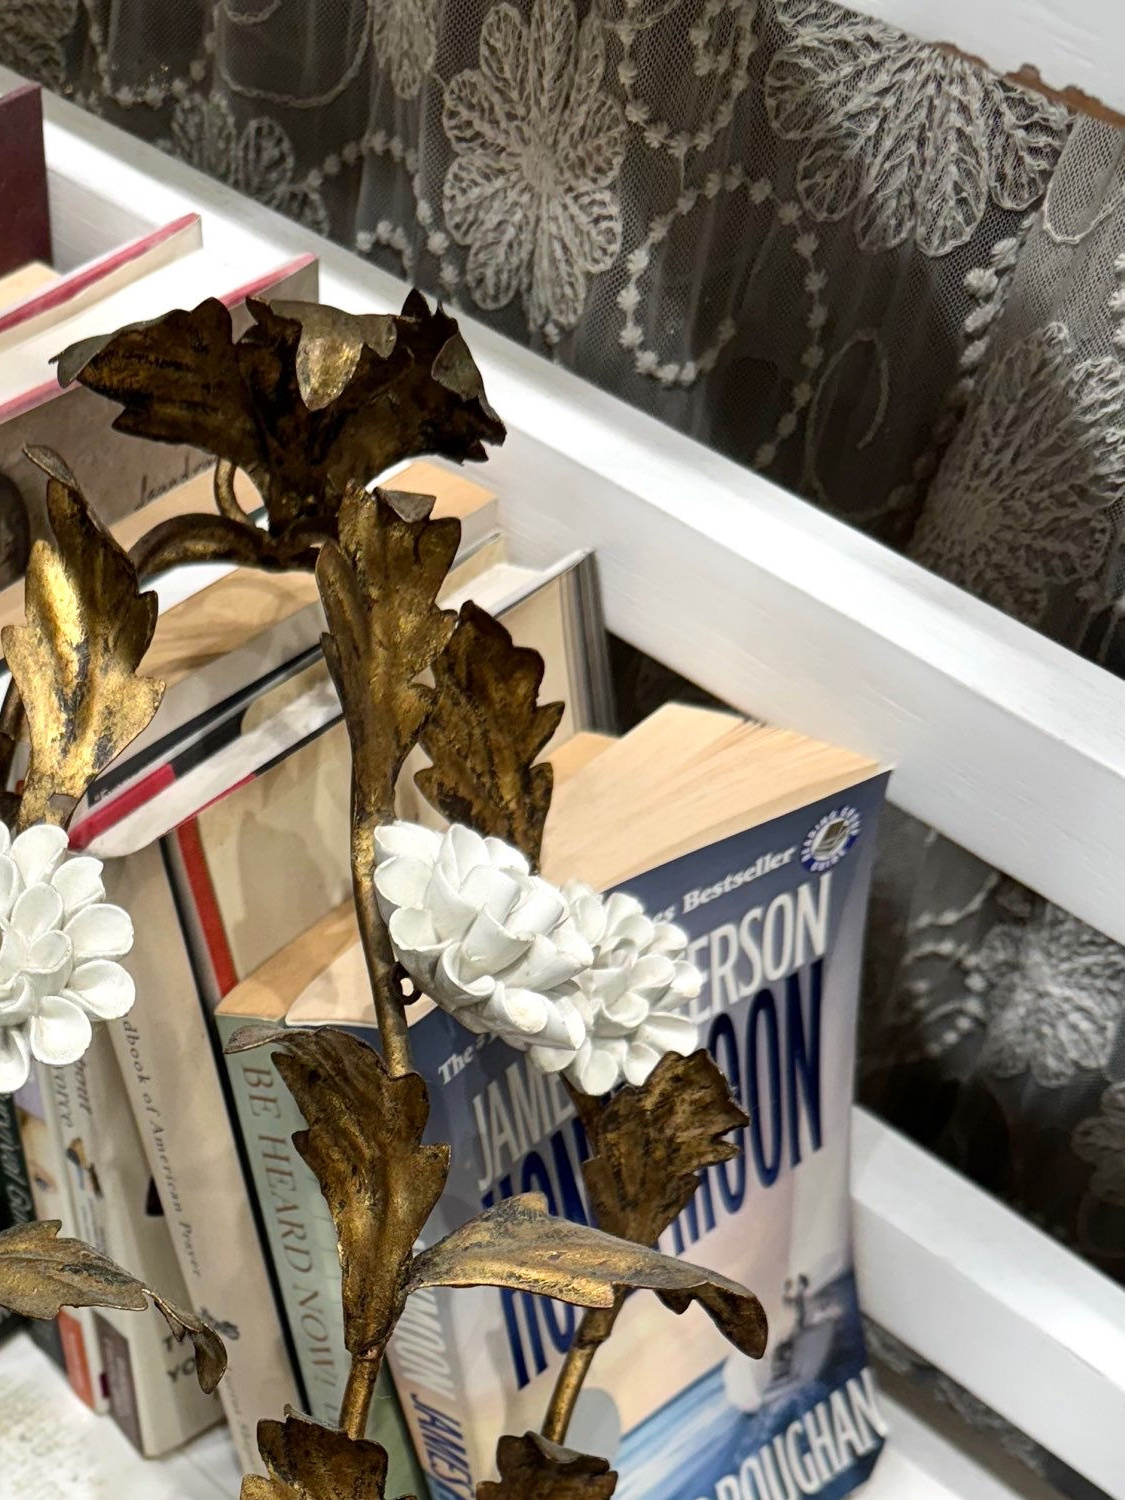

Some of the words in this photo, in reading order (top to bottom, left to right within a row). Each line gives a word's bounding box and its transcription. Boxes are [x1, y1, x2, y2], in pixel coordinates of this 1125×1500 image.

[438, 1047, 473, 1086] The
[681, 844, 798, 914] Bestseller
[123, 1017, 151, 1083] dbook
[473, 1056, 576, 1191] JAME
[672, 872, 833, 1025] ERSON
[142, 1092, 162, 1118] of
[242, 1065, 281, 1119] BE
[149, 1119, 183, 1213] American
[257, 1133, 314, 1274] HEARD
[411, 1391, 475, 1497] JAMES
